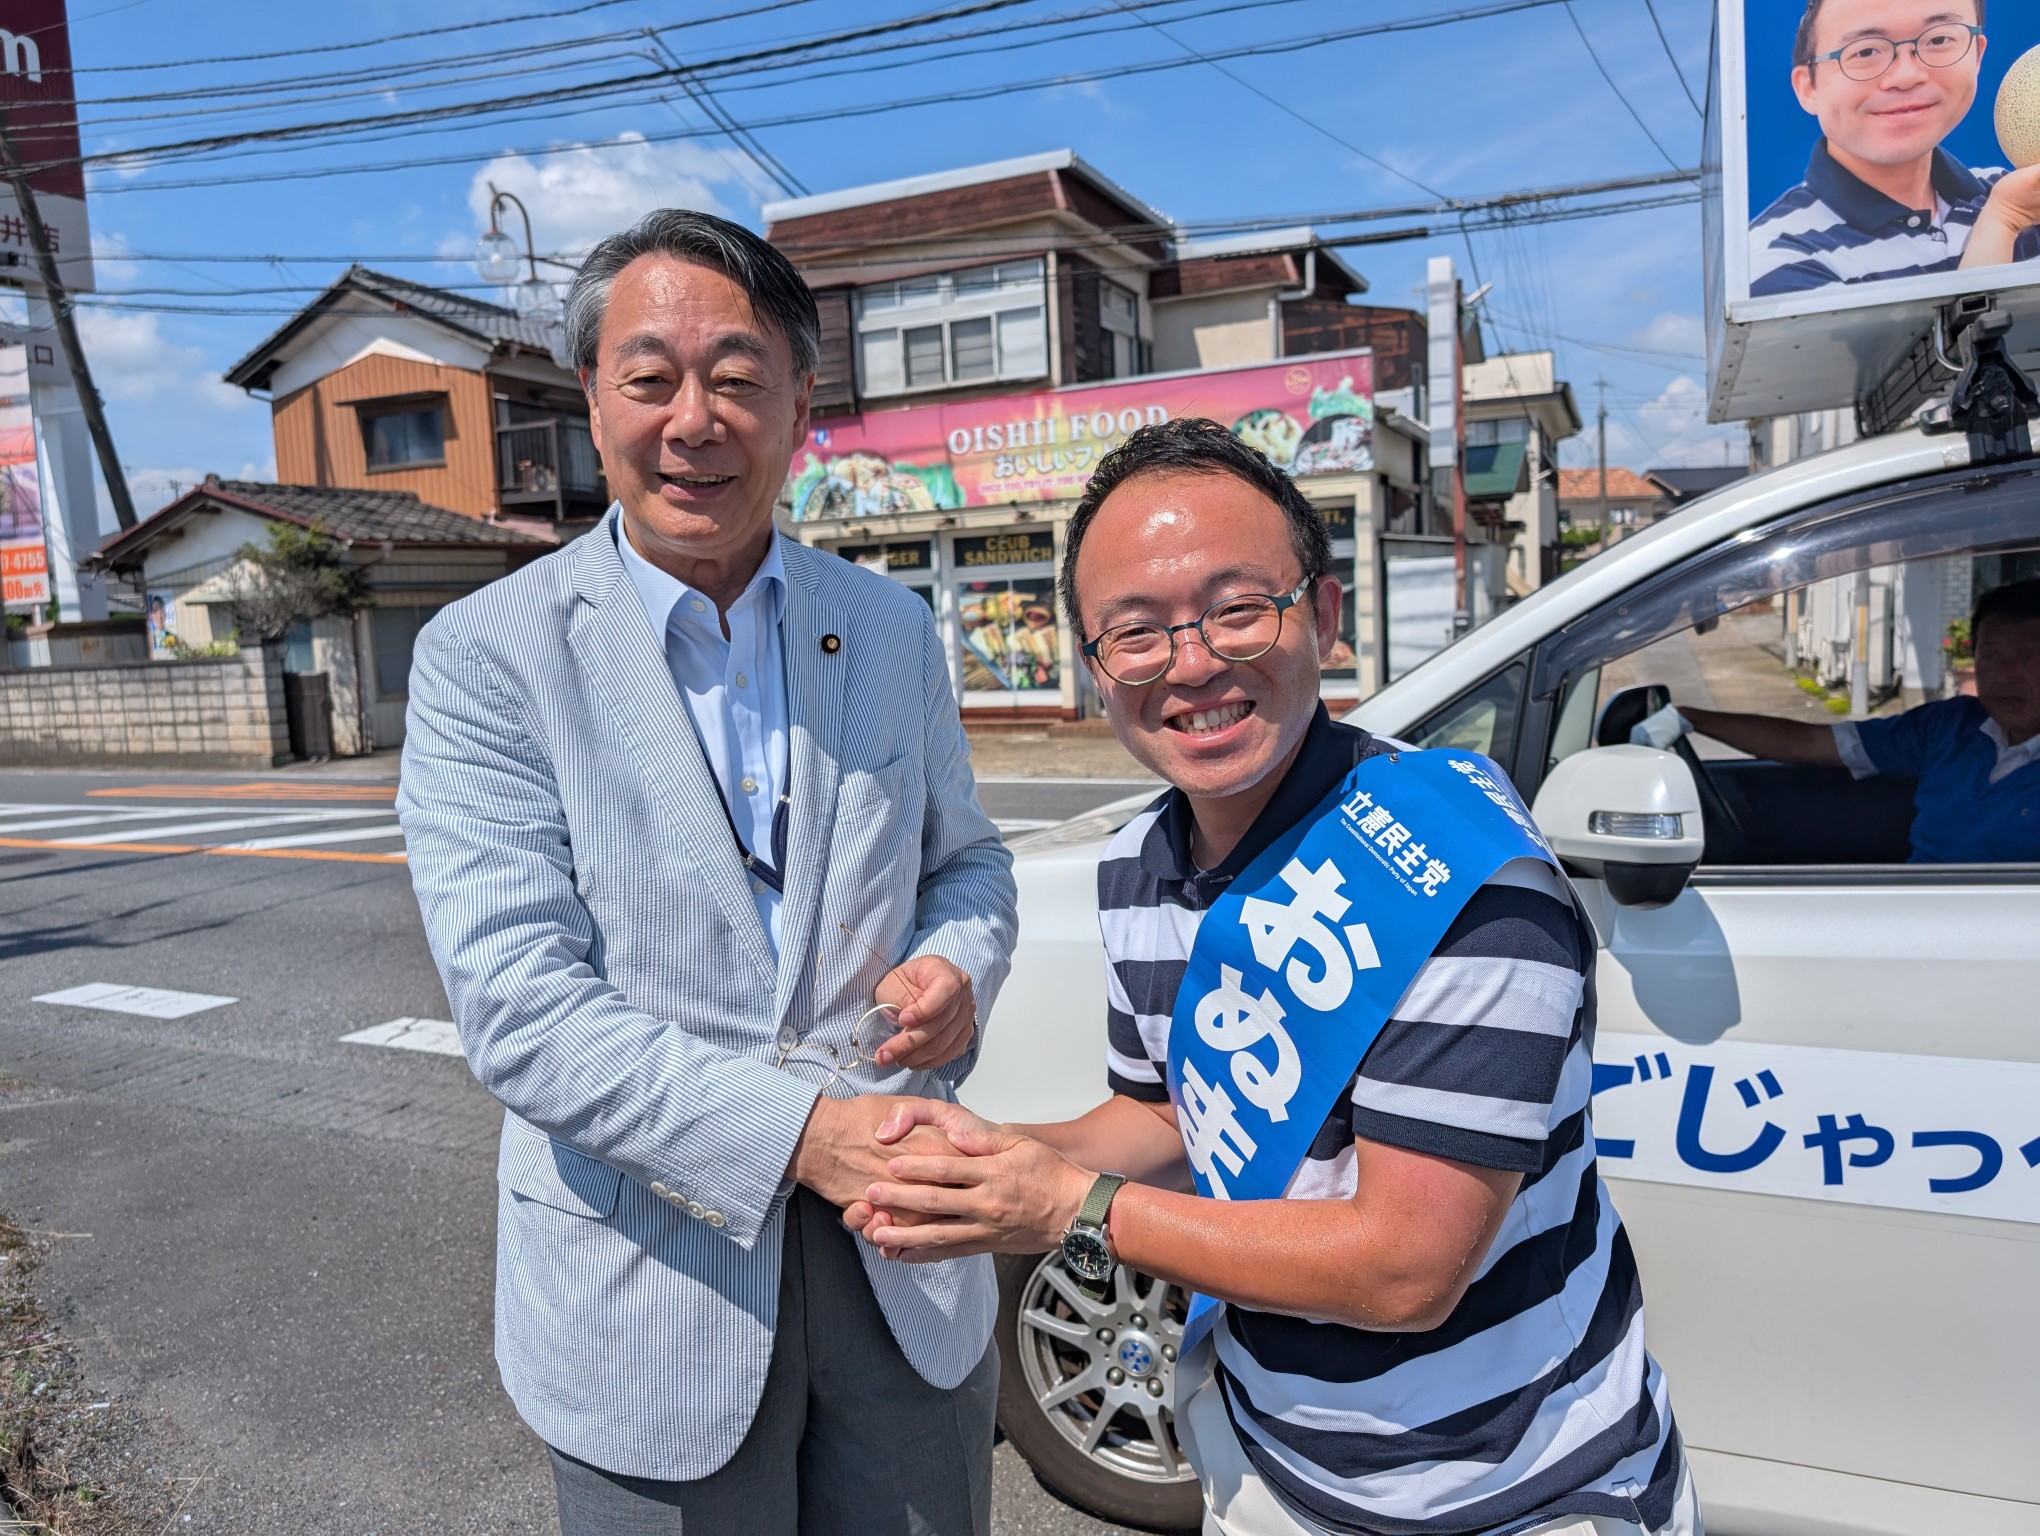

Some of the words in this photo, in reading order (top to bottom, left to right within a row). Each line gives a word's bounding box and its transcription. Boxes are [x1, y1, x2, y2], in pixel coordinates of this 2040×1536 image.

[947, 419, 1058, 455] OISHII
[1069, 405, 1169, 441] FOOD
[993, 441, 1113, 478] おいしいフ
[963, 547, 1053, 567] SANDWICH
[1340, 790, 1452, 898] 立憲民主党
[1340, 817, 1348, 826] The
[1345, 823, 1370, 849] Constitutional
[1367, 846, 1391, 869] Democratic
[1388, 866, 1401, 880] Party
[1399, 877, 1407, 886] of
[1403, 882, 1418, 897] Japan
[1176, 856, 1383, 1202] おぬま
[1592, 1051, 2040, 1194] ごじゃっ
